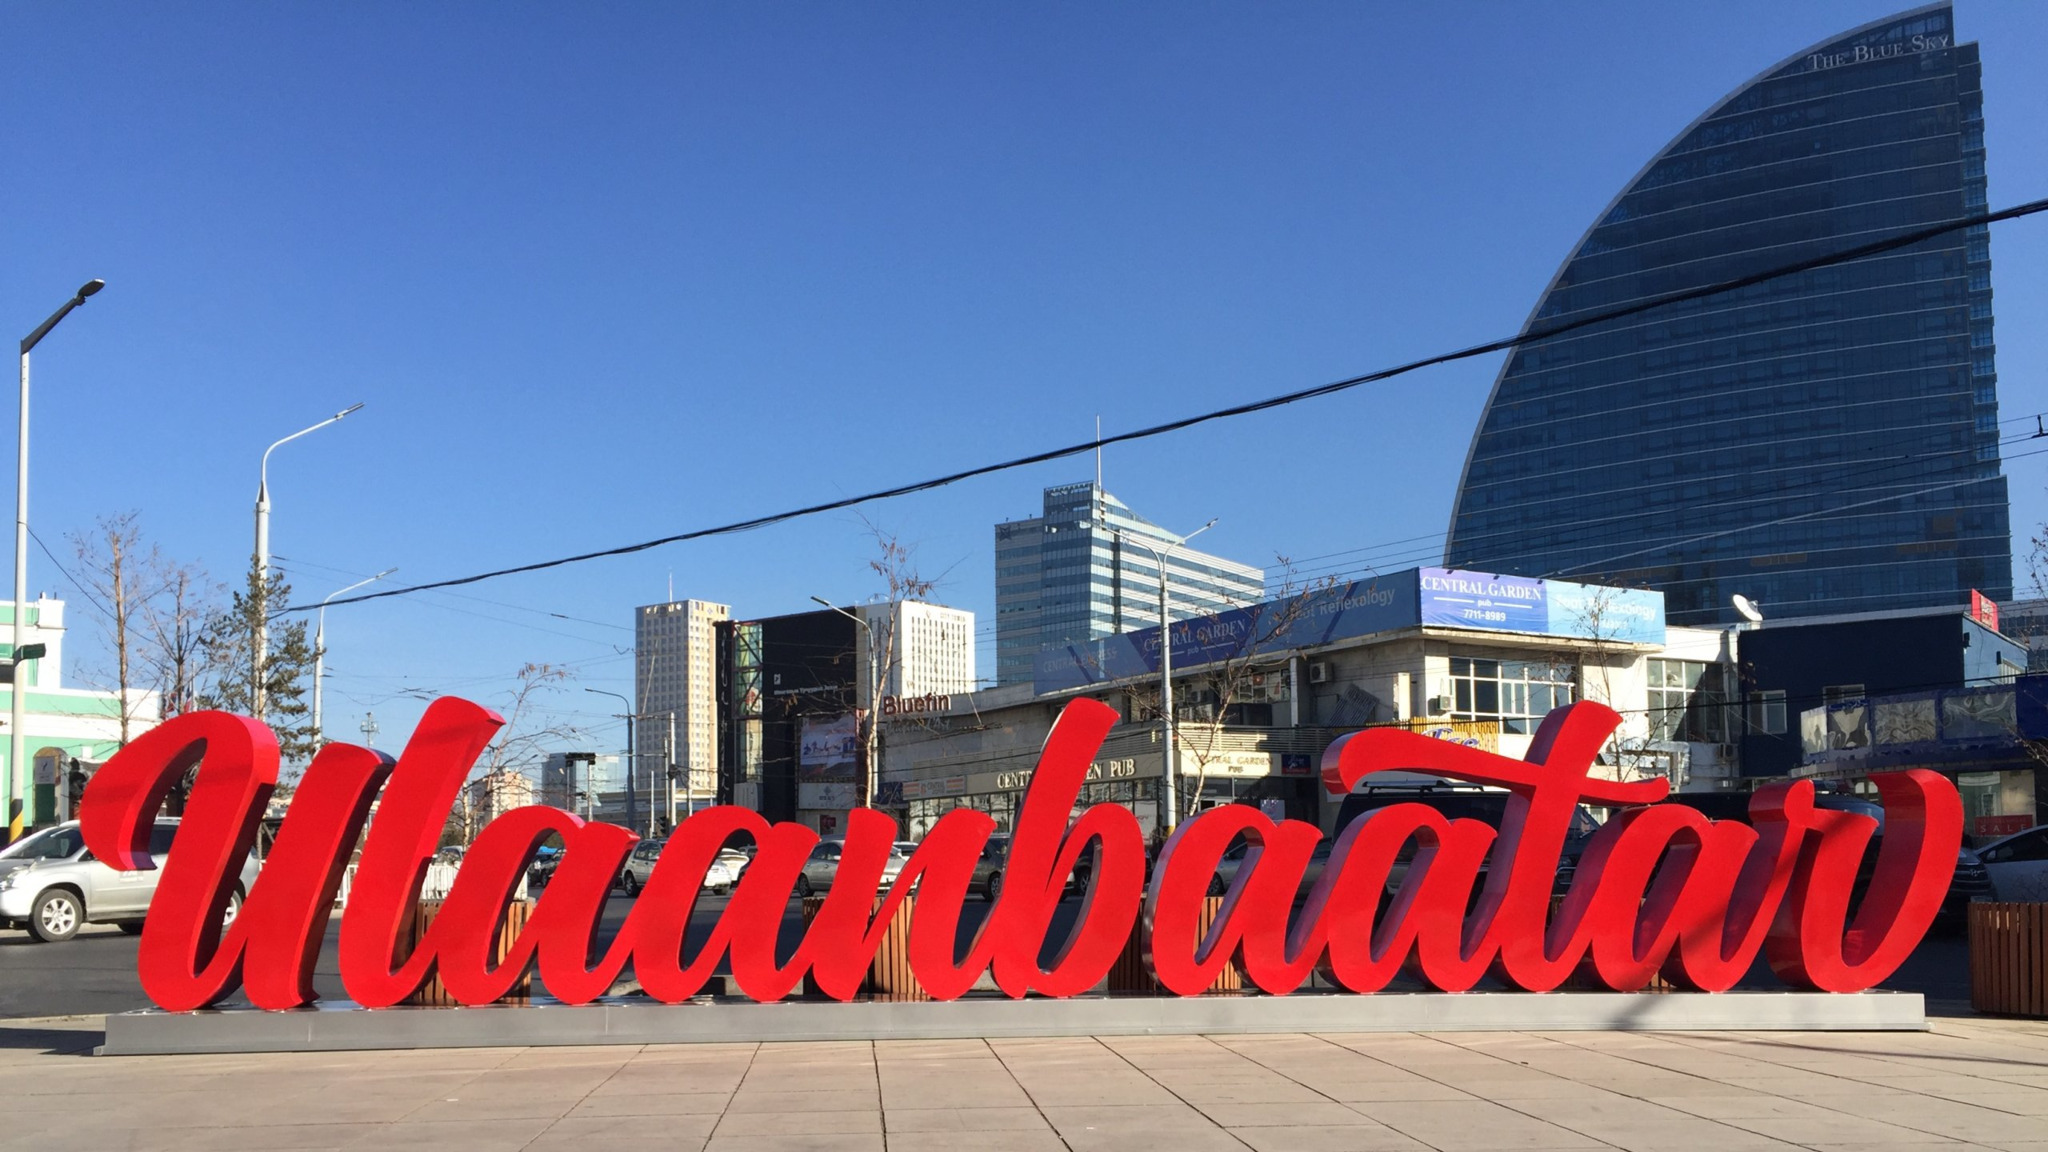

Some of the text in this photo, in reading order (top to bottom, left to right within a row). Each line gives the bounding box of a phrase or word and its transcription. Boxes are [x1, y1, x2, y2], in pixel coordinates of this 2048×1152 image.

[1421, 576, 1542, 600] CENTRAL GARDEN
[1319, 588, 1396, 616] Reflexology
[1477, 599, 1492, 608] pub
[1463, 608, 1506, 622] 7711-8989
[1144, 619, 1246, 652] CERAL GARDEN
[1187, 645, 1199, 656] pub
[883, 690, 951, 716] Bluefin
[1110, 758, 1135, 777] PUB
[80, 695, 1963, 1011] Ulaanbaatar
